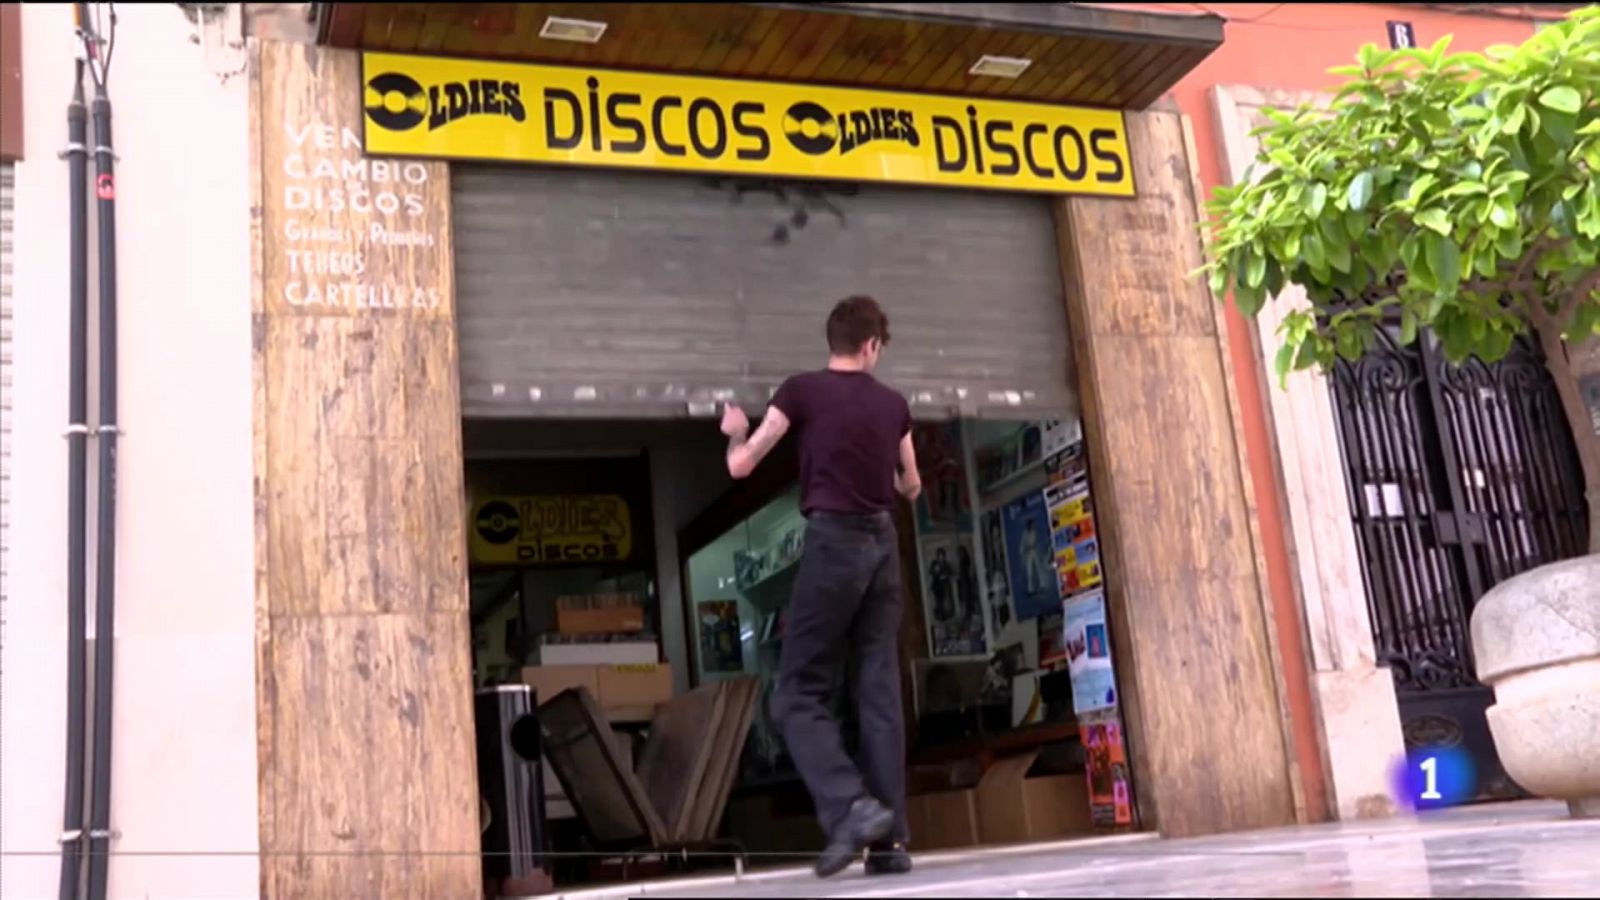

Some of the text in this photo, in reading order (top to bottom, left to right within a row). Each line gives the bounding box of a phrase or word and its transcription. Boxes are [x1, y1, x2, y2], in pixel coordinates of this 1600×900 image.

[364, 71, 526, 132] OLDIES
[782, 101, 920, 156] OLDIES
[284, 154, 428, 185] CAMBIO
[284, 185, 425, 217] DISCOS
